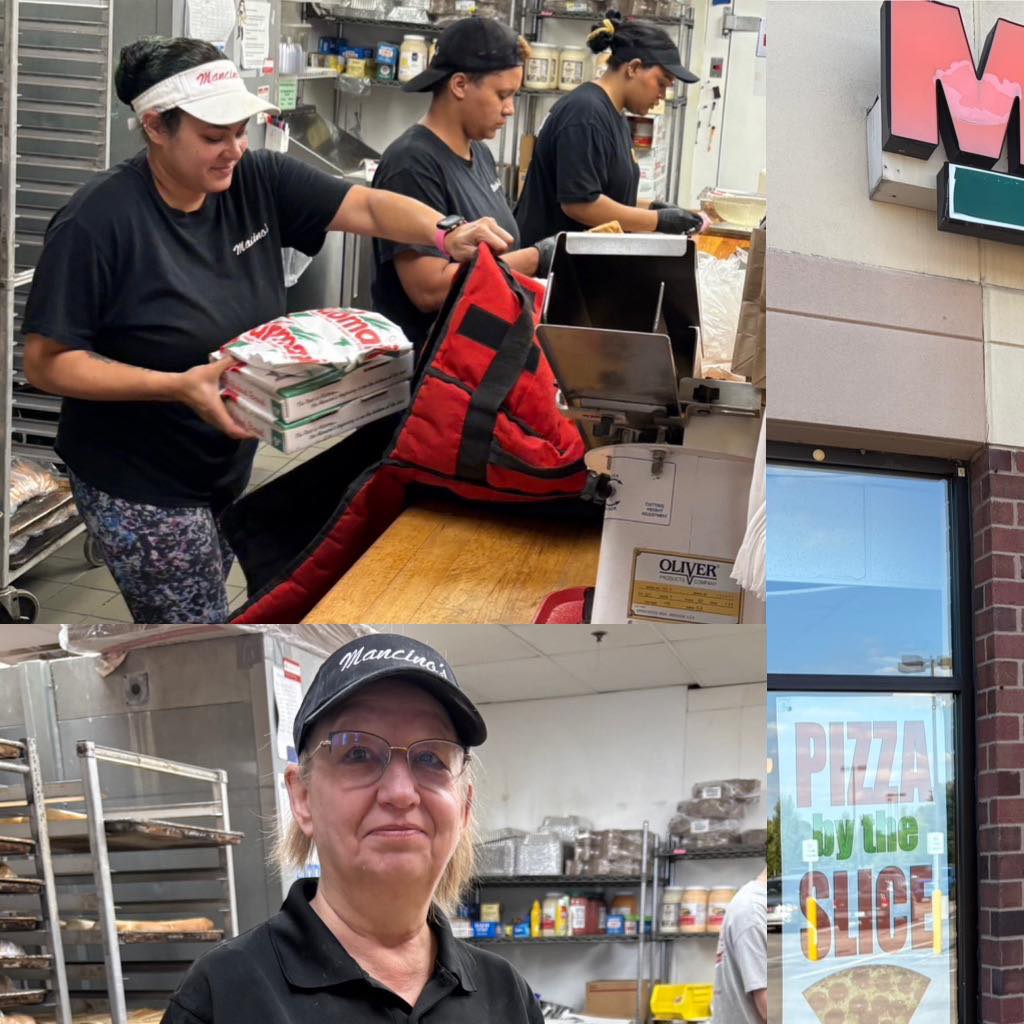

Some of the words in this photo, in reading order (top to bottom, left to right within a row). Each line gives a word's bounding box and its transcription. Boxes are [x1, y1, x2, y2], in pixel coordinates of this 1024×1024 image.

[659, 558, 717, 577] OLIVER
[338, 645, 448, 680] Mancino's
[795, 720, 935, 809] PIZZA
[812, 812, 856, 861] by
[862, 809, 920, 853] the
[799, 863, 935, 962] SLICE
